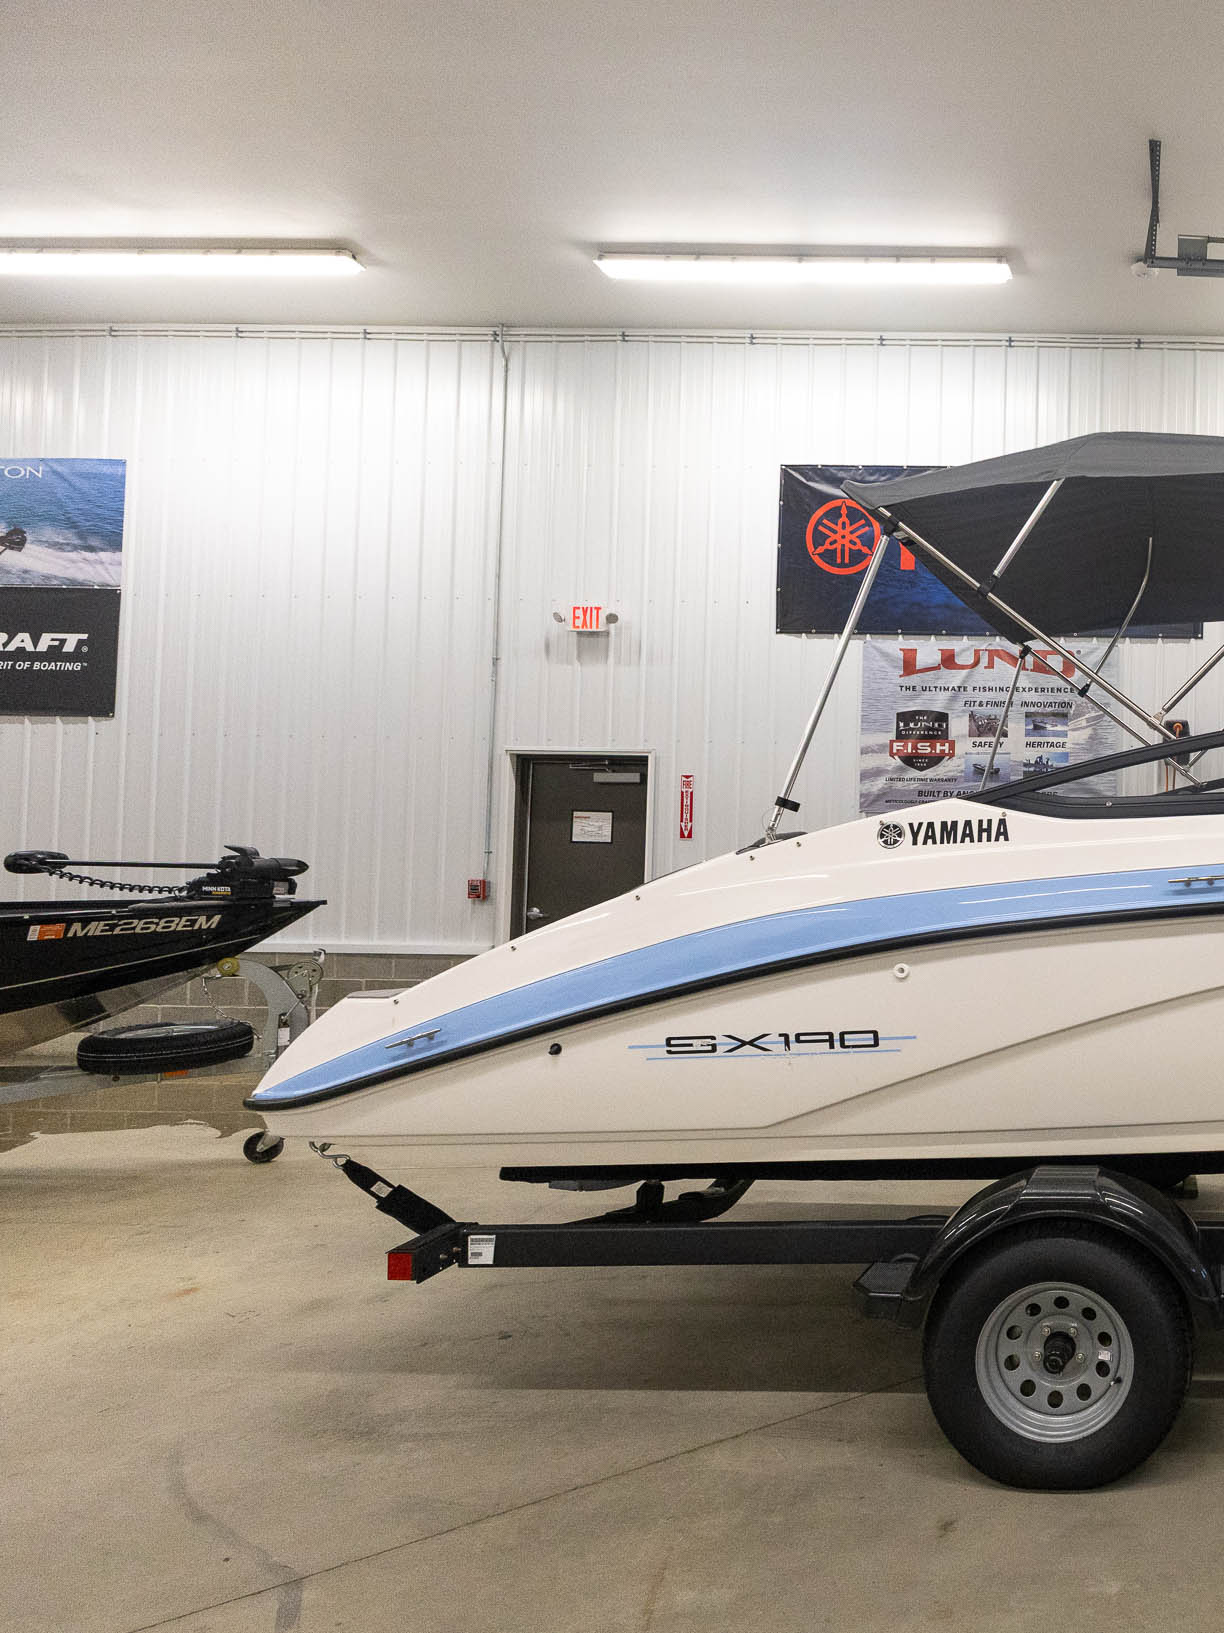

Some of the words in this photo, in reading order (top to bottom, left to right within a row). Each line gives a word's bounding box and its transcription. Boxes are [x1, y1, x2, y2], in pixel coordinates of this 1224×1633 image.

[0, 466, 42, 478] ON
[572, 606, 602, 629] EXIT
[0, 661, 13, 670] IT
[15, 661, 31, 670] OF
[899, 648, 1077, 678] LUND
[1015, 686, 1075, 694] EXPERIENCE
[963, 700, 978, 708] FIT
[978, 700, 985, 708] &
[985, 700, 1014, 708] FINIS
[1020, 701, 1073, 709] INNOVATION
[893, 742, 953, 753] F.I.S.H.
[1025, 741, 1067, 749] HERITAGE
[917, 790, 940, 798] BUILT
[943, 790, 954, 798] BY
[908, 818, 1010, 846] YAMAHA
[67, 914, 222, 938] ME268EM
[665, 1030, 880, 1055] SX190
